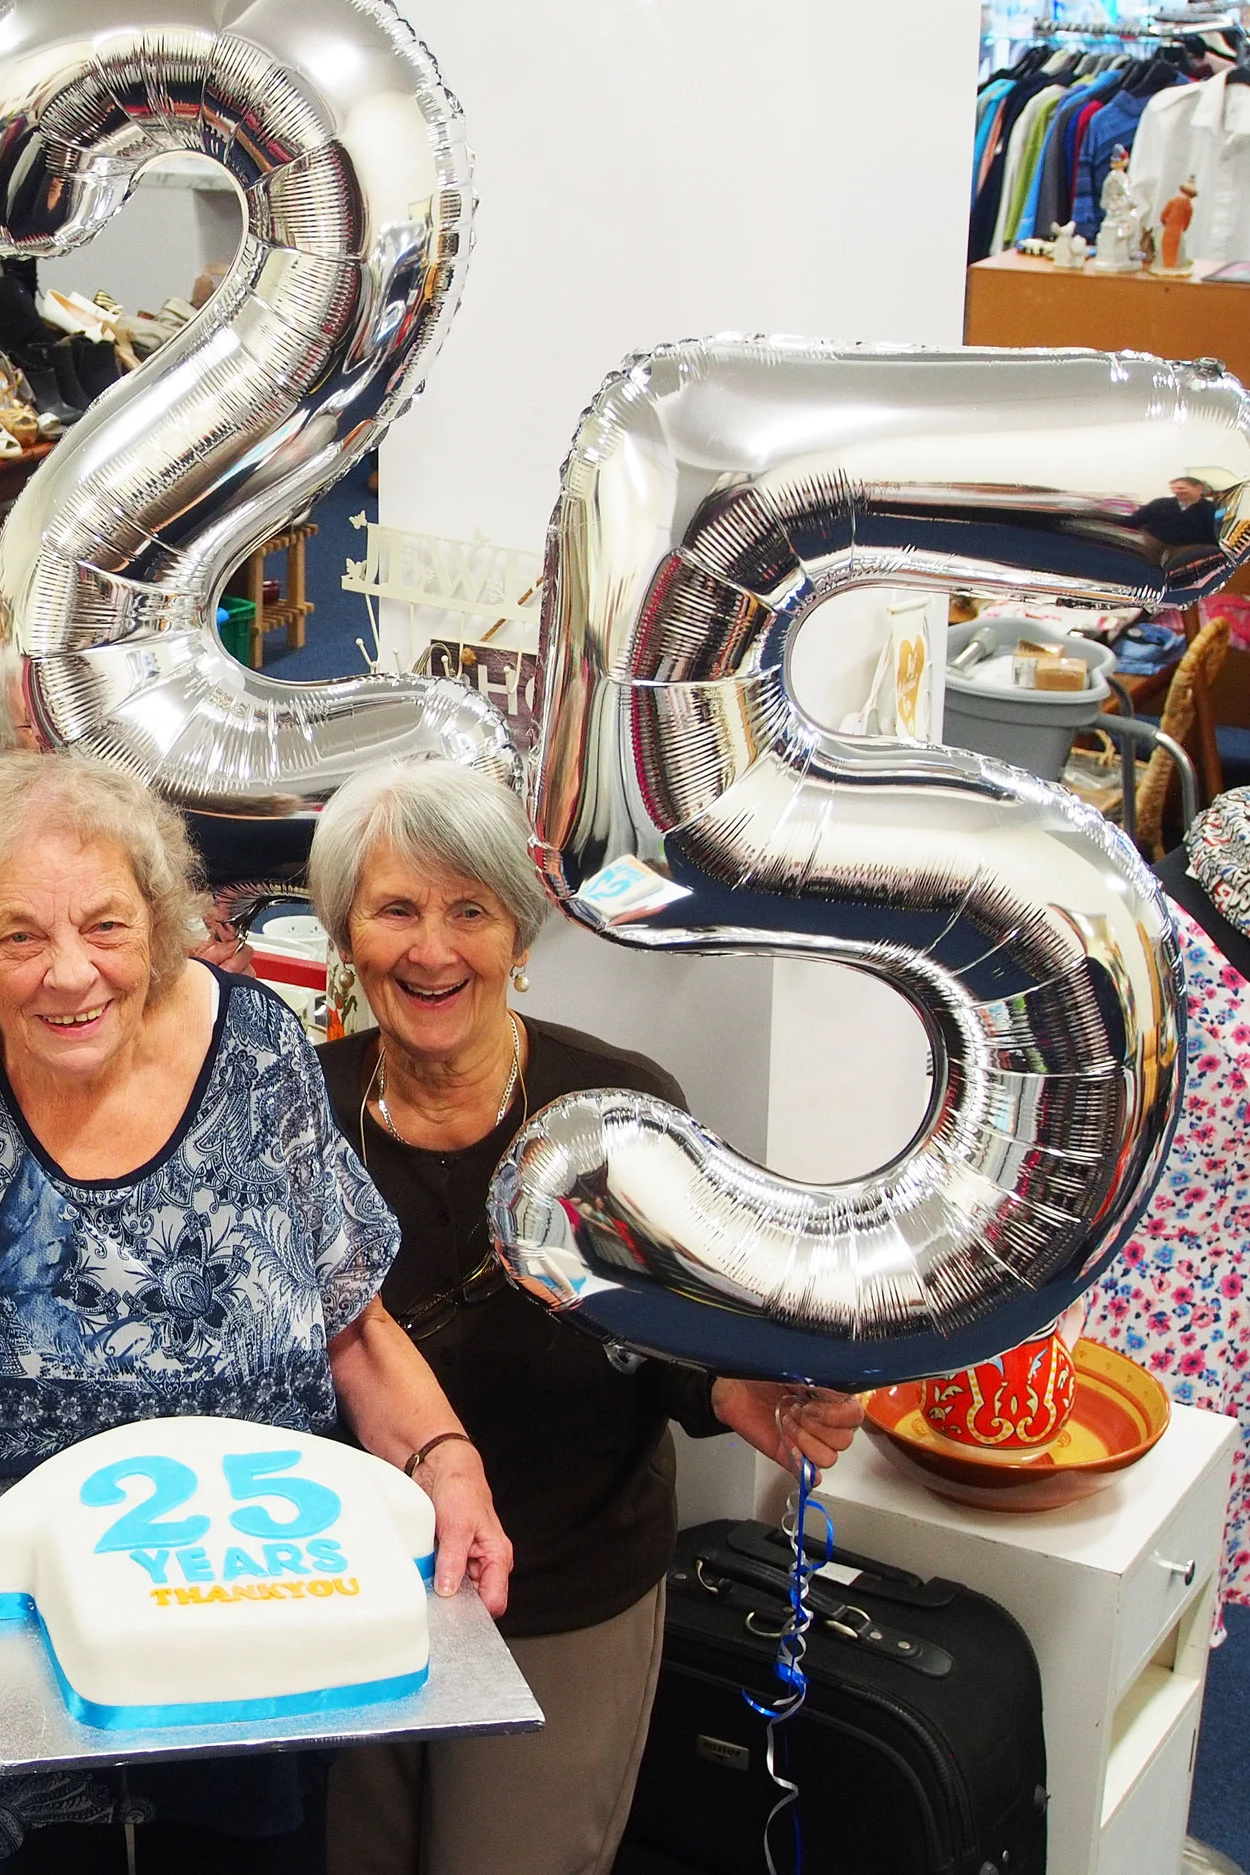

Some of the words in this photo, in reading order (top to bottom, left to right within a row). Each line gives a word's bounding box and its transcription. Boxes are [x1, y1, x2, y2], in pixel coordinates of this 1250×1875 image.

[80, 1450, 342, 1554] 25
[129, 1538, 349, 1584] YEARS
[150, 1577, 360, 1606] THANKYOU
